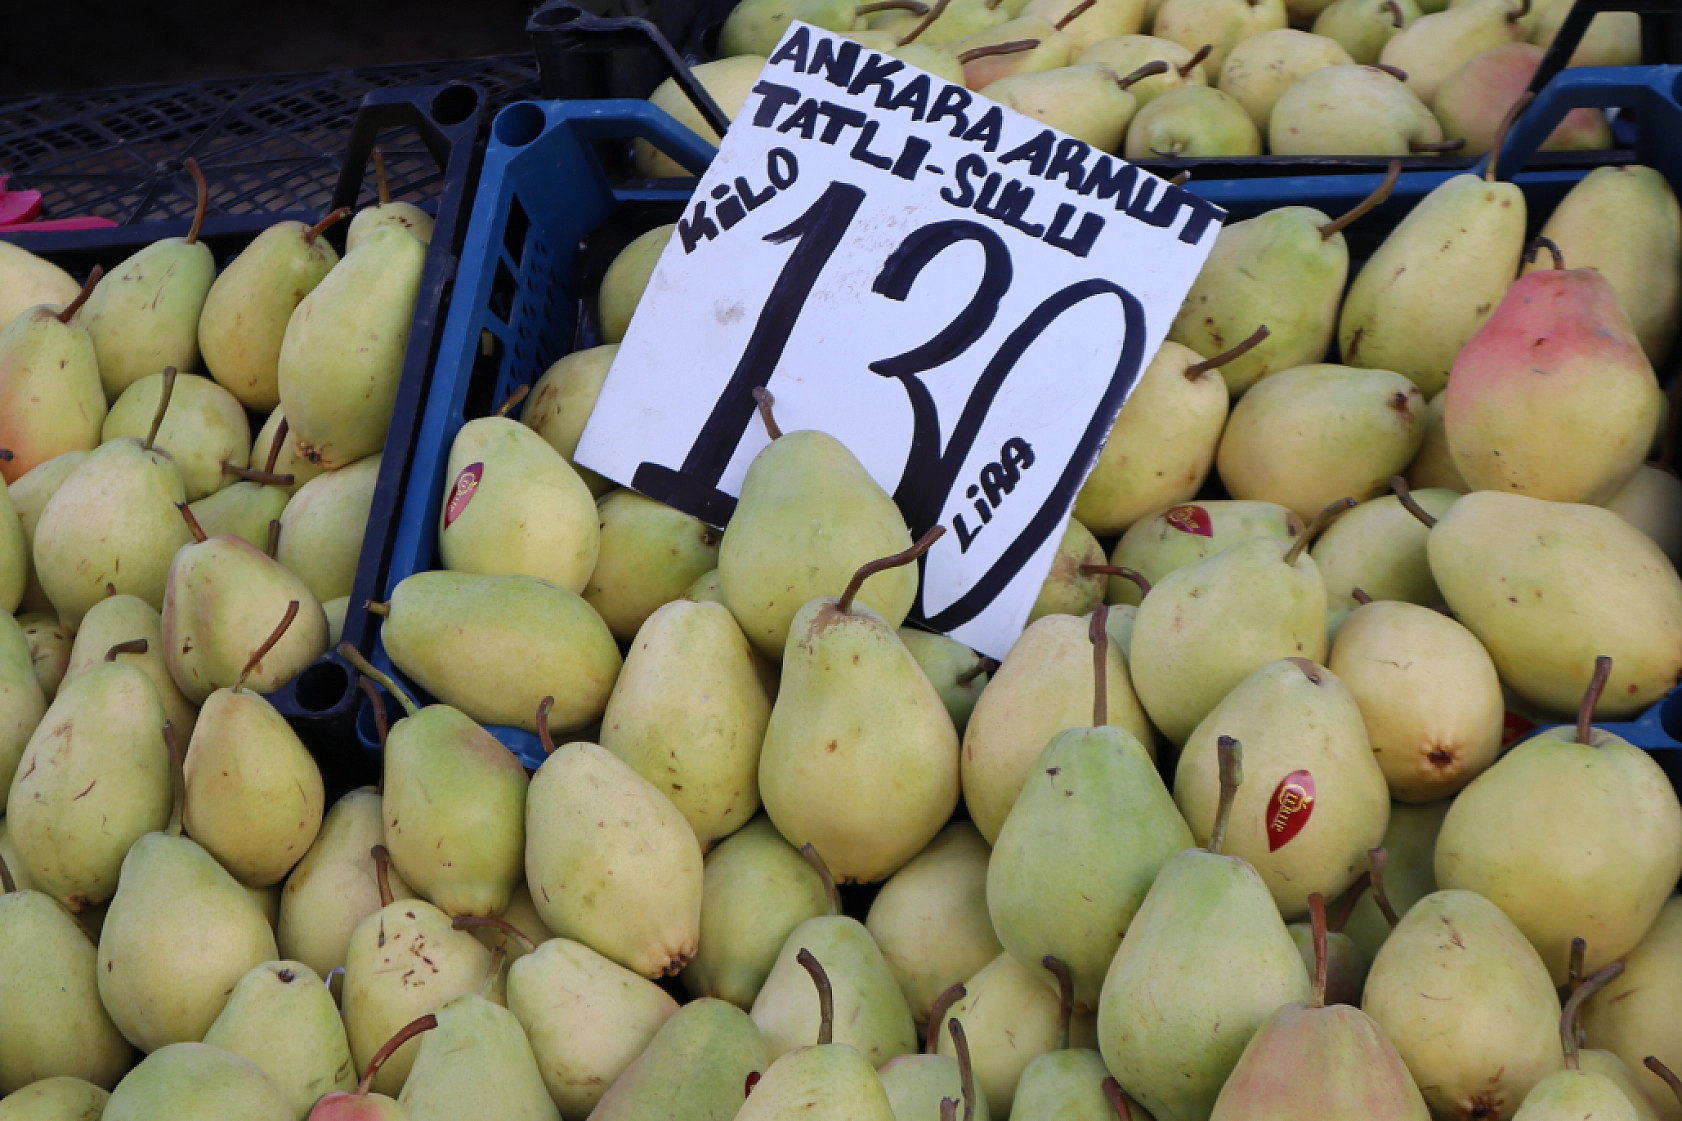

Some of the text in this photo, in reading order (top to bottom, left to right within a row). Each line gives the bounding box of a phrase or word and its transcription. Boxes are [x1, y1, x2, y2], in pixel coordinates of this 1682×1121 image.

[772, 25, 1226, 246] ANKARA ARMUT
[631, 180, 1147, 634] 130
